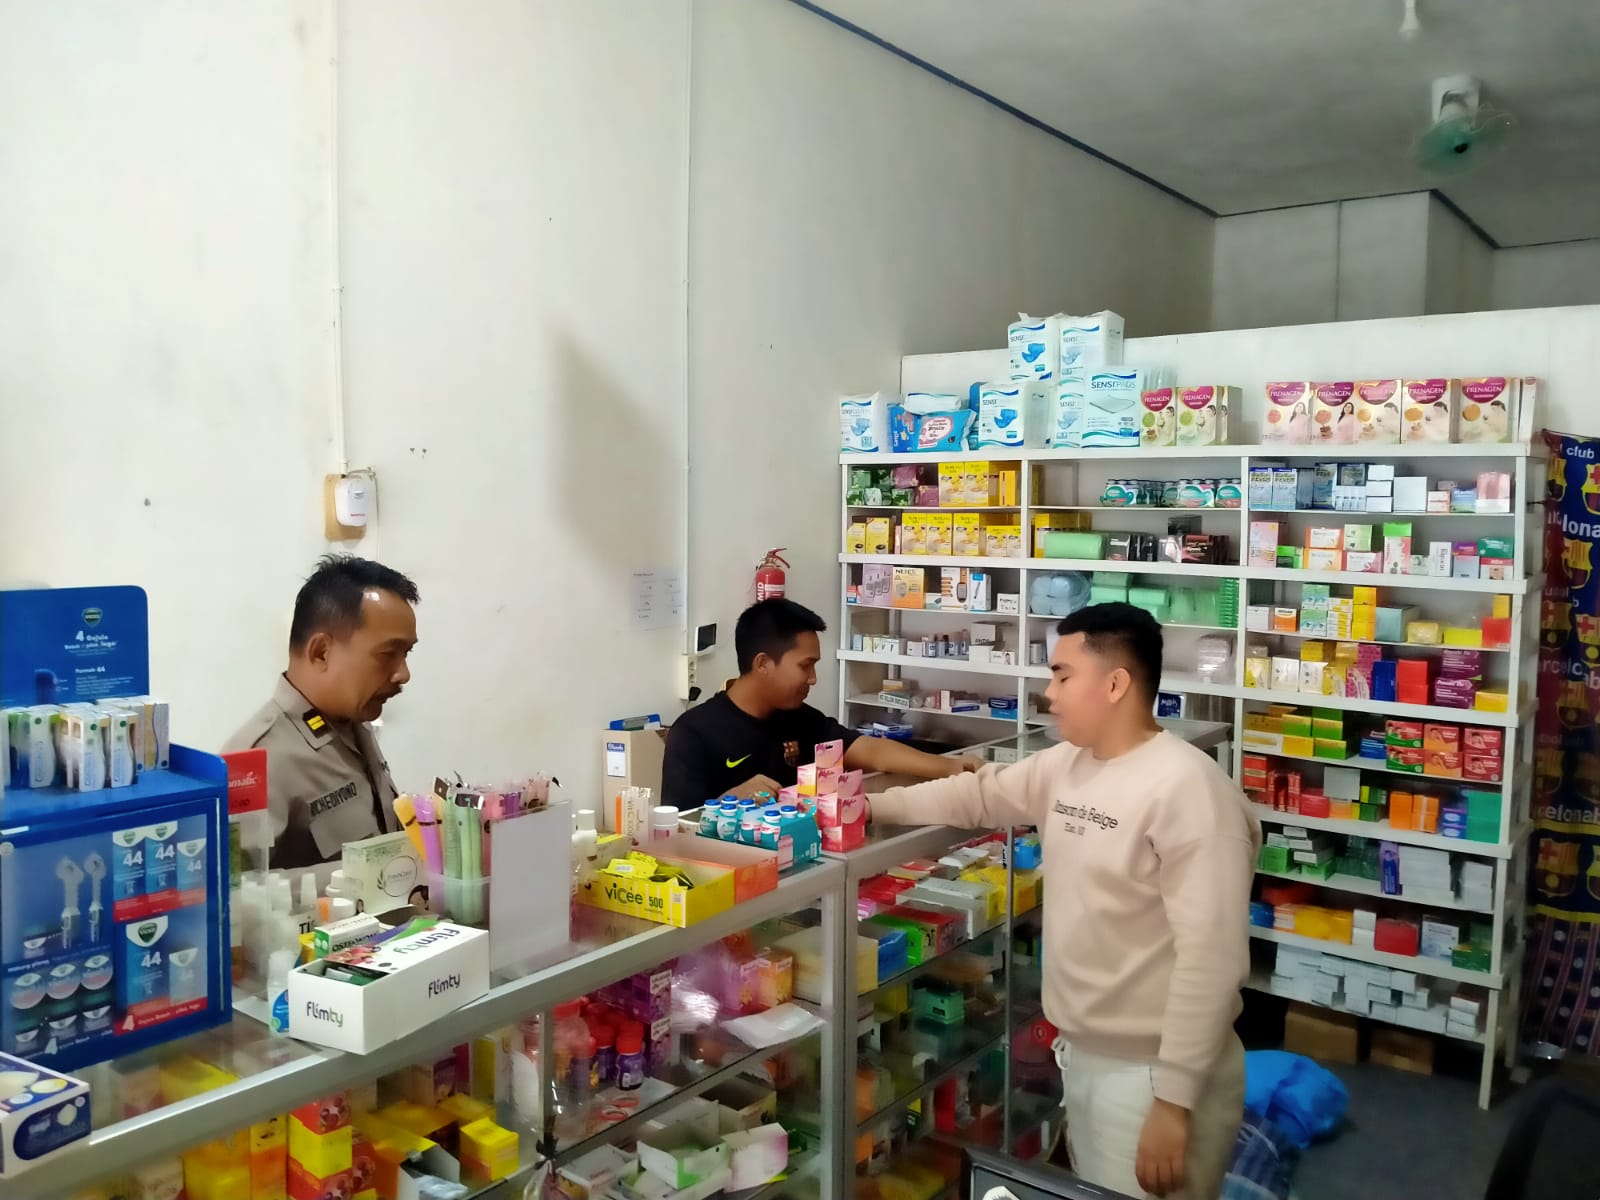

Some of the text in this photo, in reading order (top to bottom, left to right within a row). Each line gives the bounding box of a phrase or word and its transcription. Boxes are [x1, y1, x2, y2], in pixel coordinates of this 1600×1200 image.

[1318, 390, 1352, 398] PRENAGEN
[1408, 385, 1444, 395] PRENAGEN
[1466, 384, 1502, 394] PRENAGEN
[1566, 445, 1595, 460] club
[1087, 807, 1119, 831] Beige
[123, 850, 144, 867] 44
[155, 844, 176, 861] 44
[187, 860, 202, 873] 44
[648, 896, 664, 910] 500
[141, 951, 162, 968] 44
[122, 1015, 135, 1031] 4
